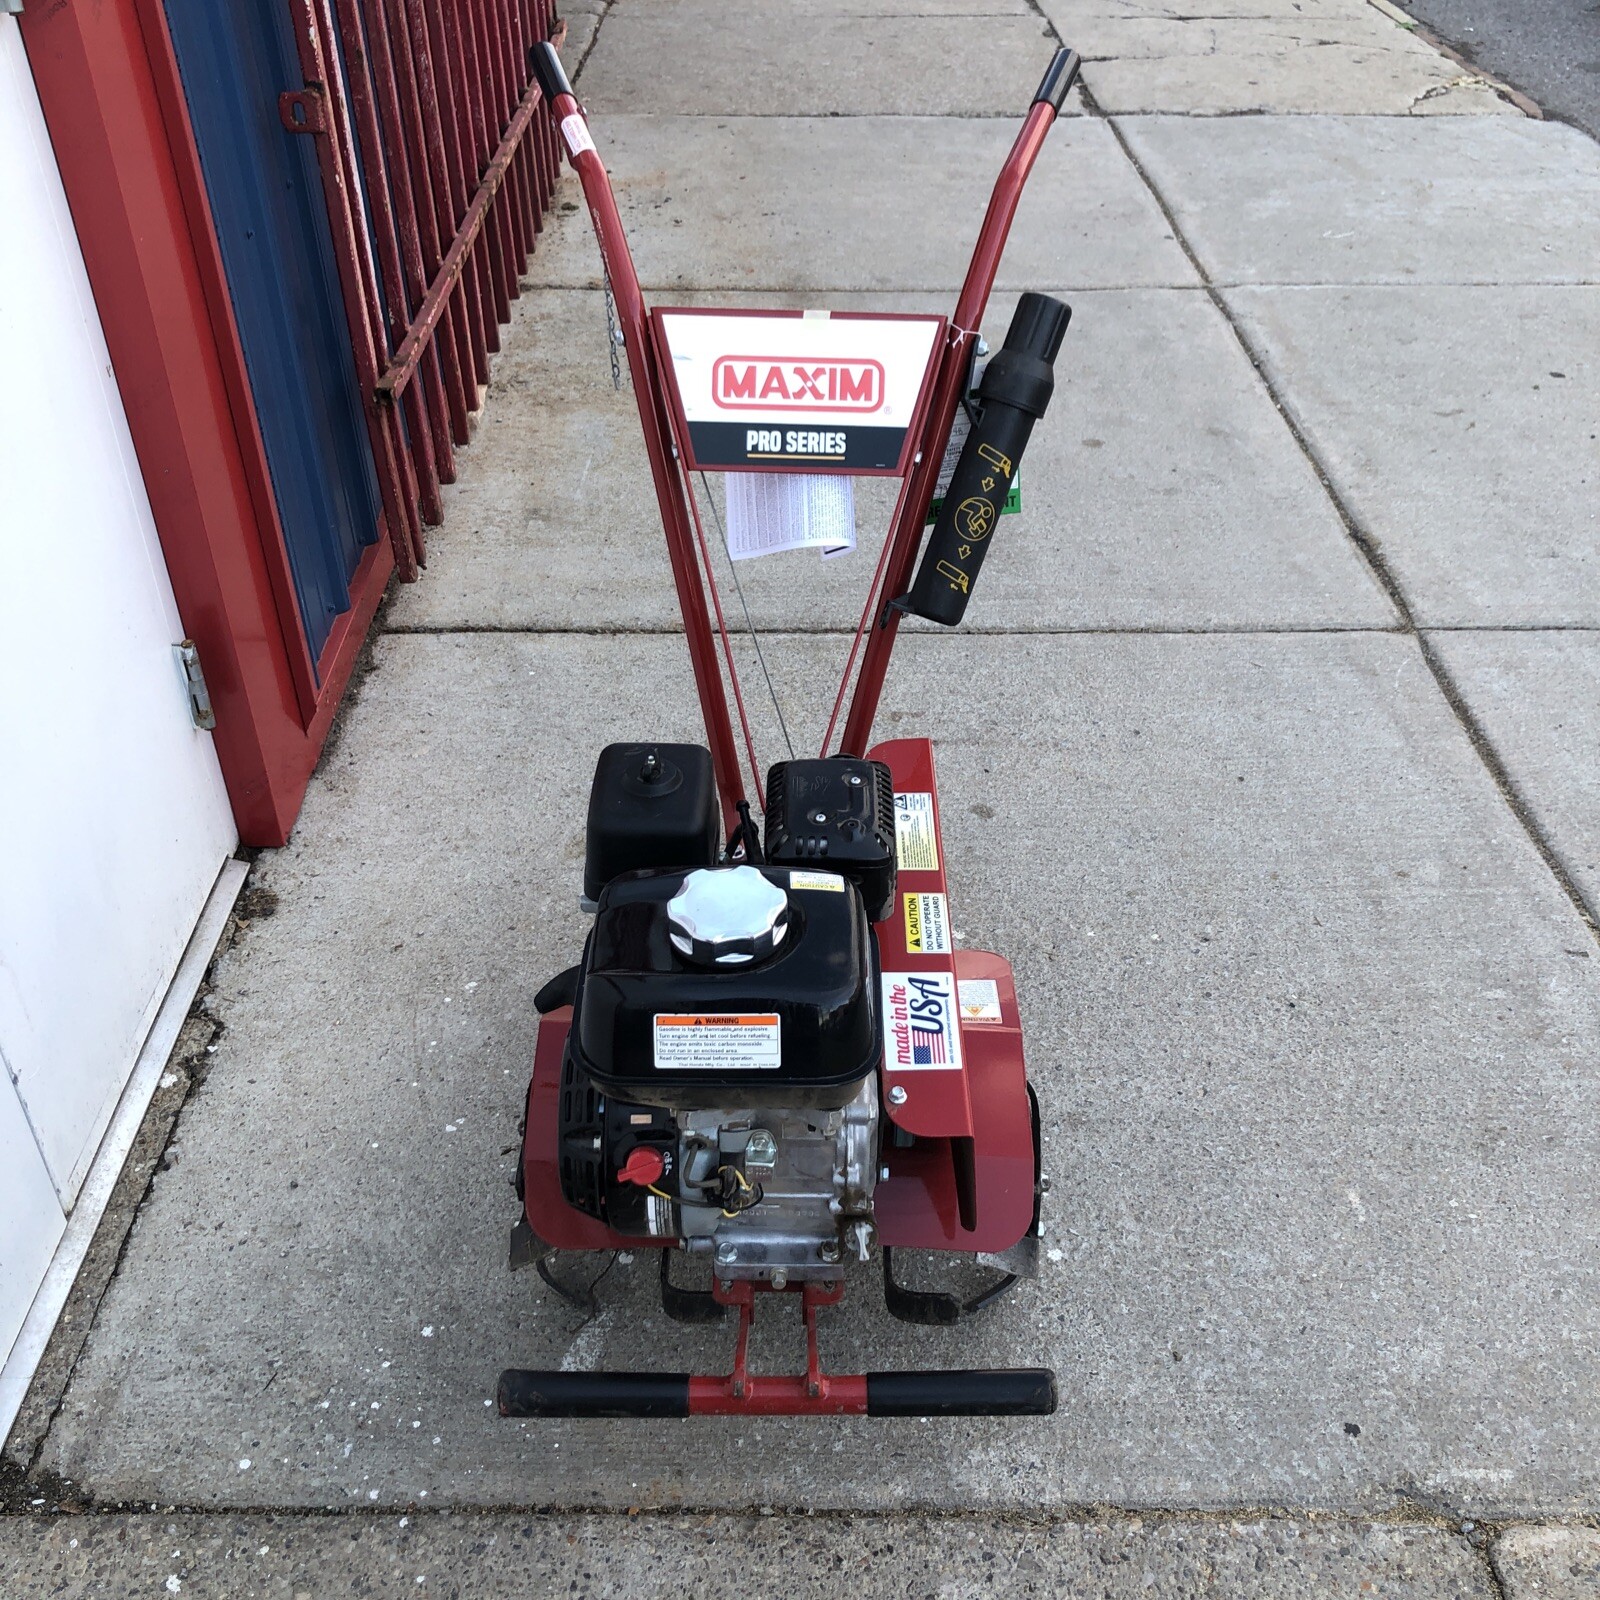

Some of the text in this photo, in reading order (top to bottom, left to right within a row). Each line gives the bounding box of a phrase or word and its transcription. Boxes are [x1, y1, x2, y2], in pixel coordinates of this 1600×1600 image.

[723, 364, 873, 402] MAXIM
[746, 430, 846, 454] PRO SERIES
[908, 898, 919, 935] CAUTION
[923, 895, 931, 924] OPERATE
[927, 940, 934, 950] DO
[935, 920, 943, 950] WITHOUT
[908, 977, 949, 1034] USA
[889, 984, 911, 1064] made in the
